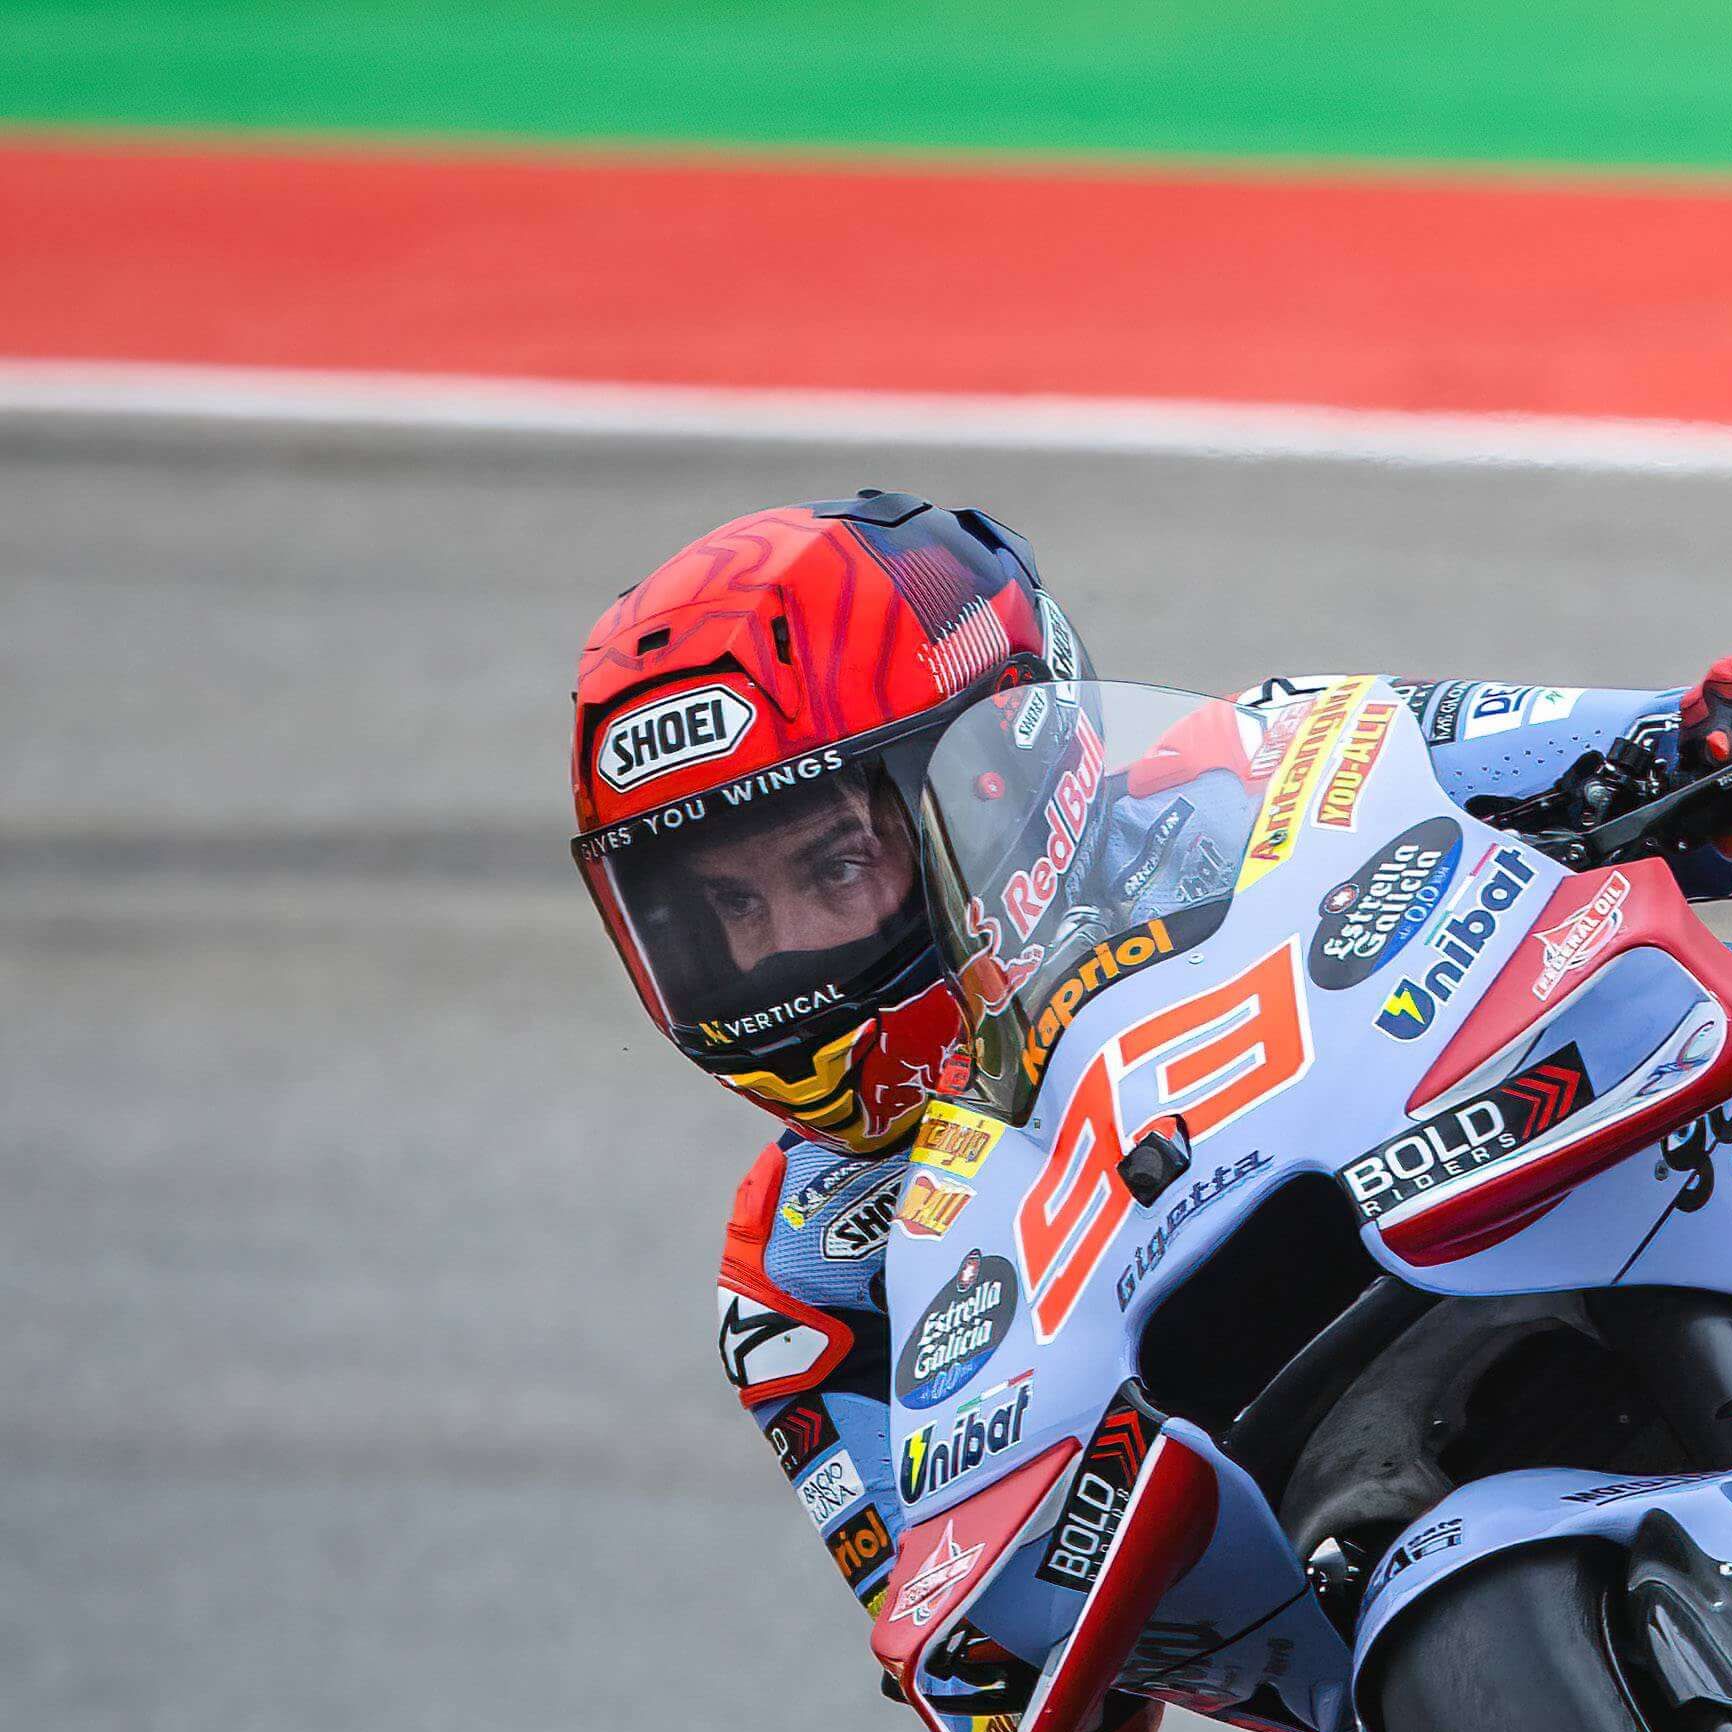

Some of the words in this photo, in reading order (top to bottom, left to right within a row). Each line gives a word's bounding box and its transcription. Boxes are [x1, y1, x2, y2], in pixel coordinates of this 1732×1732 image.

[611, 700, 728, 776] SHOEI
[1319, 704, 1396, 825] YOU-ALL
[643, 799, 706, 835] YOU
[722, 750, 842, 805] WINGS
[1323, 845, 1419, 960] Estrella
[1354, 851, 1442, 957] Galicia
[1376, 847, 1538, 1038] Unibat
[725, 984, 845, 1037] VERTICAL
[1021, 919, 1173, 1085] Kapriol
[1013, 933, 1315, 1345] 93
[1346, 1100, 1506, 1203] BOLD
[1361, 1132, 1517, 1216] RIDERS
[835, 1182, 900, 1251] SHO
[914, 1320, 993, 1380] Galicia
[917, 1281, 1002, 1346] Estrella
[900, 1384, 1034, 1507] Unibat
[834, 1511, 889, 1577] riol
[1048, 1472, 1116, 1579] BOLD
